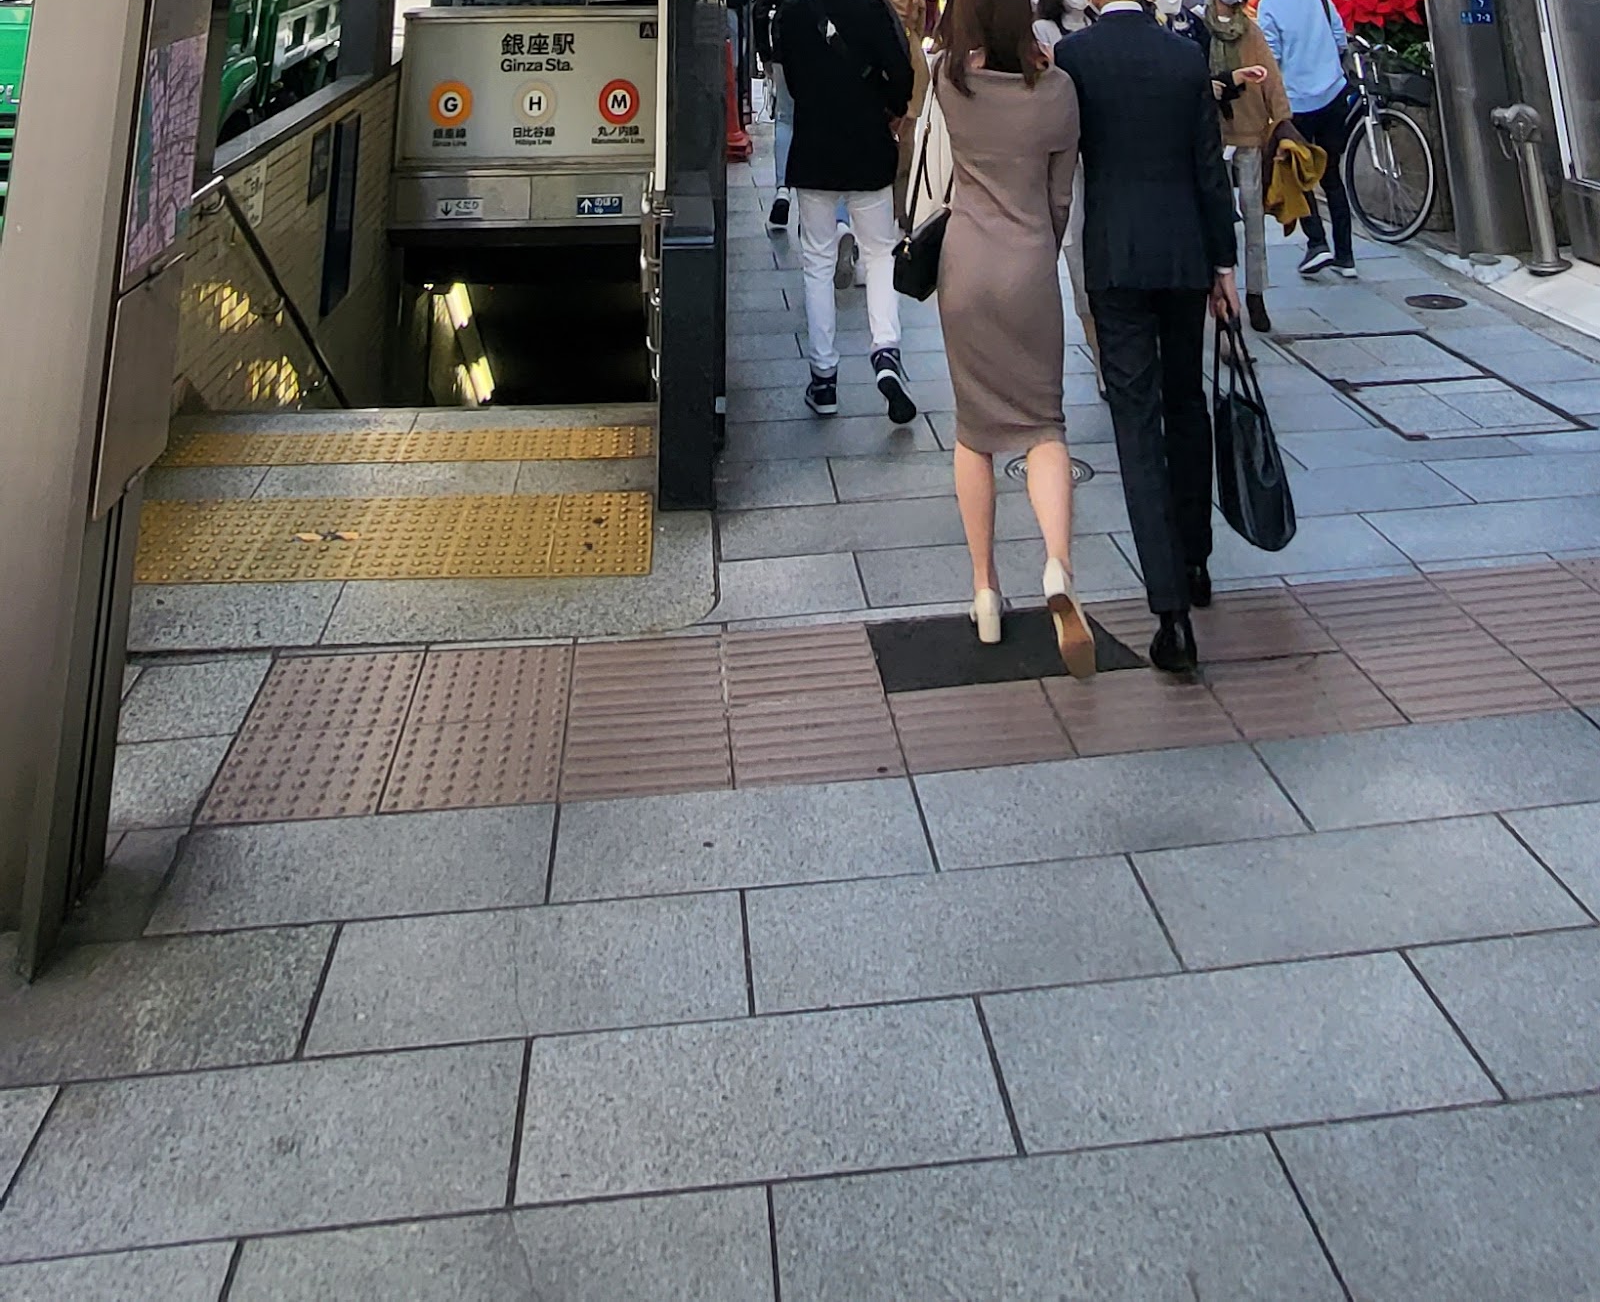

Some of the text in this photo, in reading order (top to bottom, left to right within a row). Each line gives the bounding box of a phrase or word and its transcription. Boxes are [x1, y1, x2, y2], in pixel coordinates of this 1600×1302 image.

[500, 32, 576, 56] 銀座駅
[500, 57, 574, 73] Ginza Sta.
[443, 96, 459, 112] G
[528, 96, 543, 111] H
[610, 94, 628, 109] M
[512, 126, 556, 138] 日比谷線
